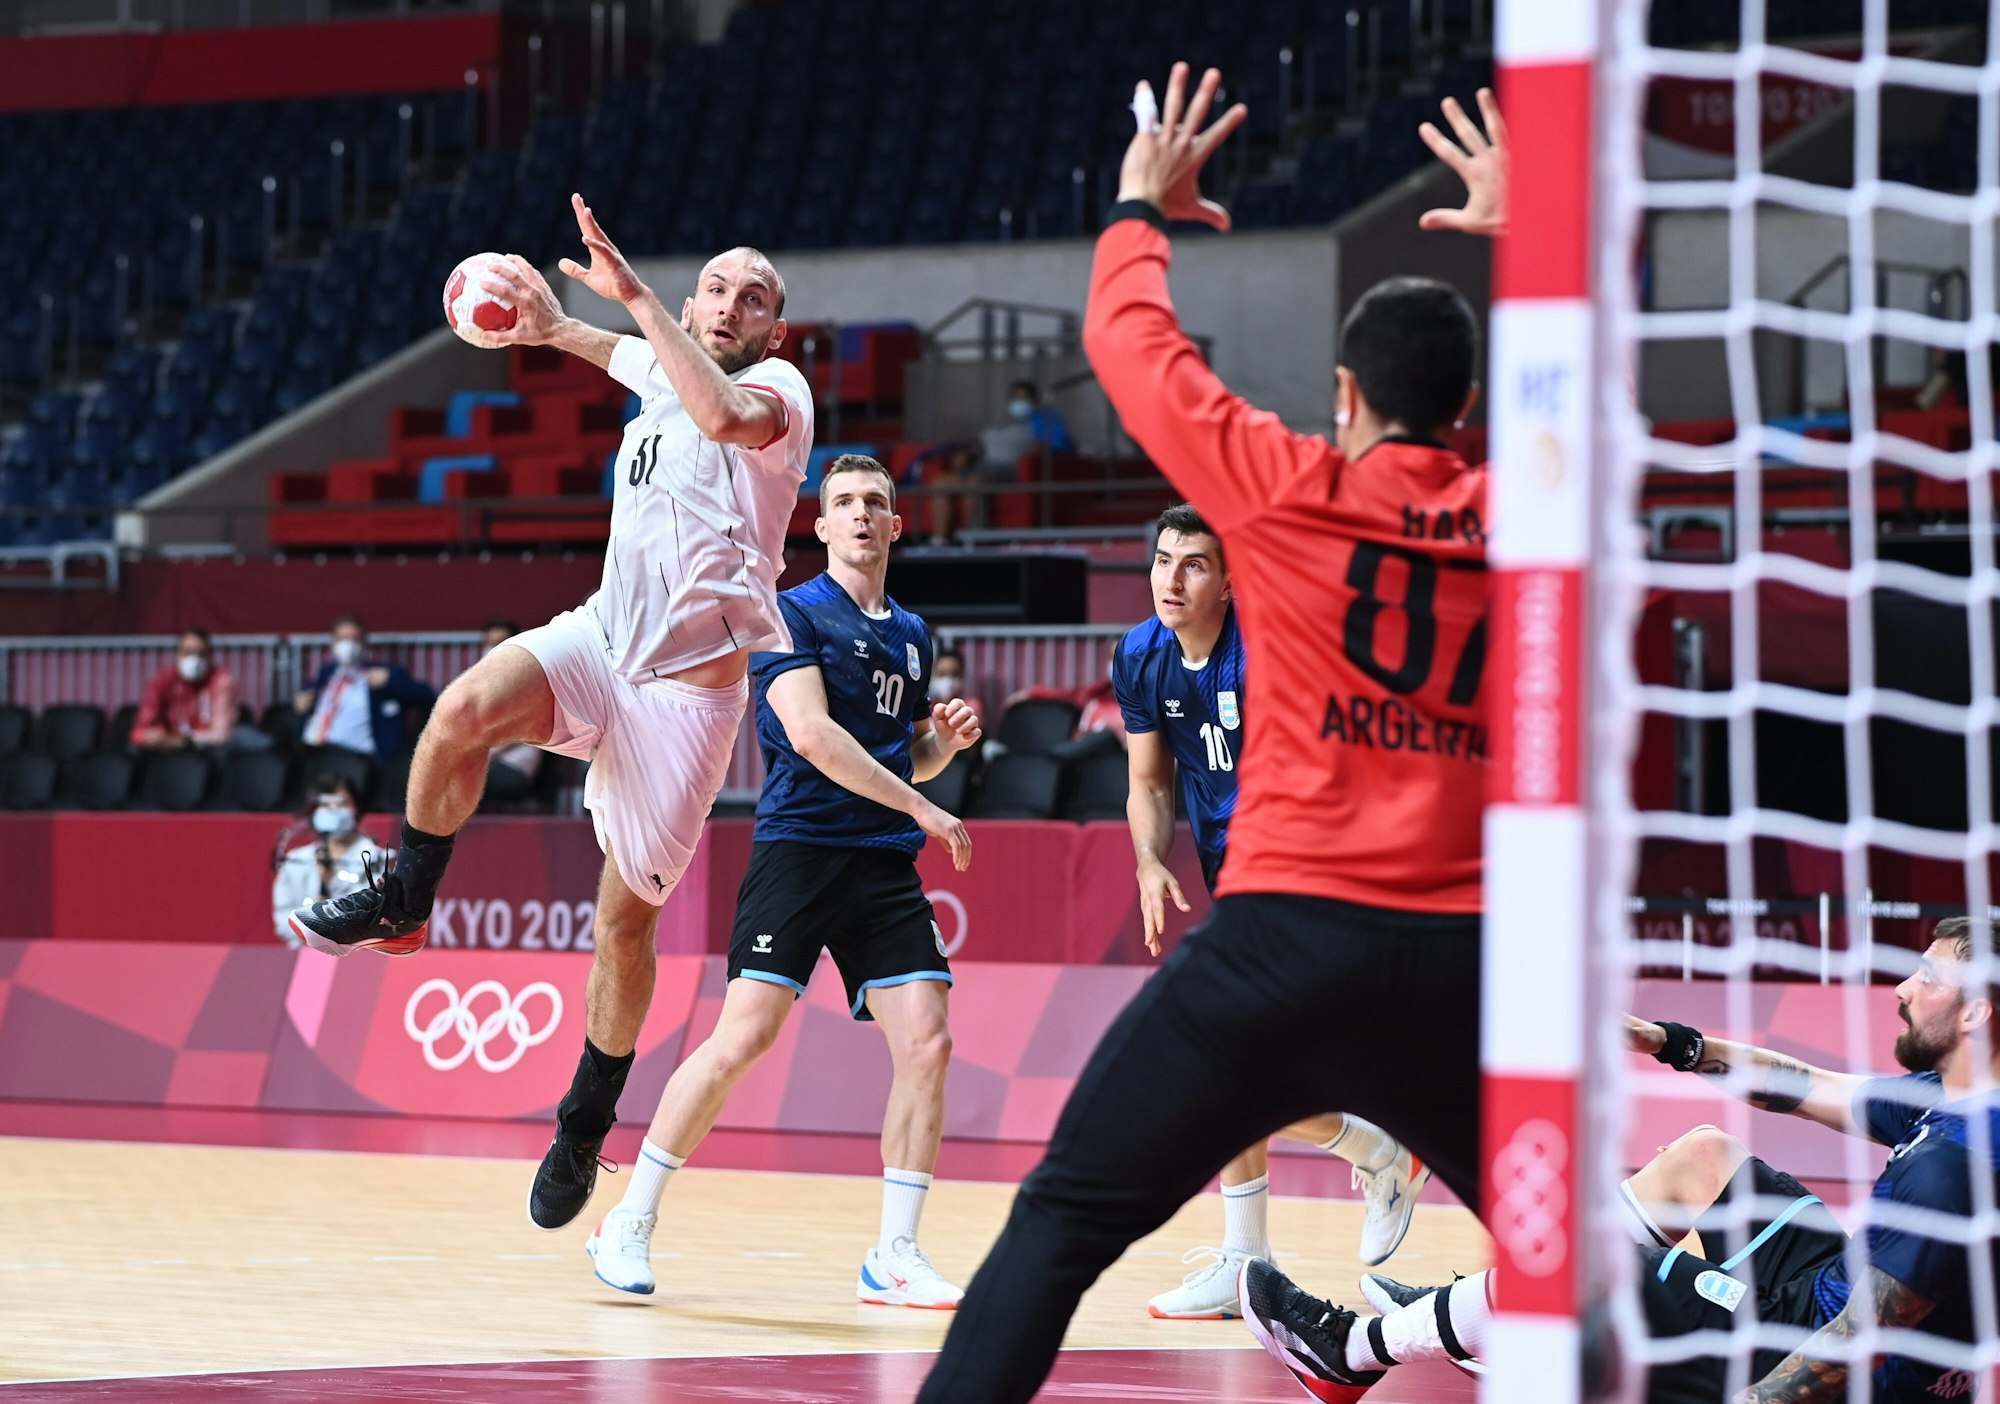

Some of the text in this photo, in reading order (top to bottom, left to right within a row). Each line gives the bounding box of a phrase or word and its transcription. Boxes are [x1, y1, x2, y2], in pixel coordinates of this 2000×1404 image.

[1344, 538, 1488, 707] 87
[872, 669, 904, 718] 20
[1199, 722, 1234, 772] 10
[430, 898, 595, 950] KYO 202
